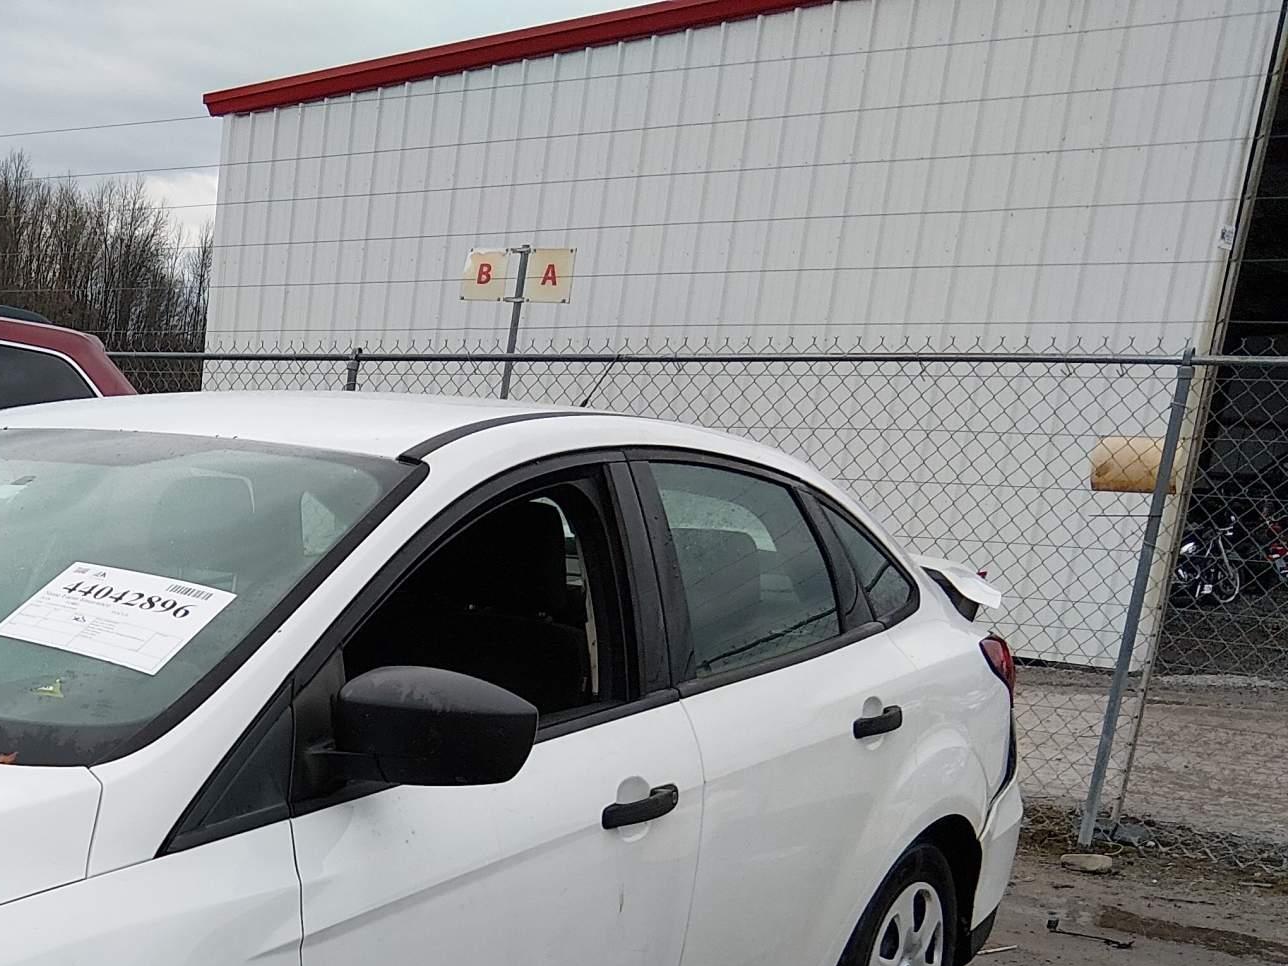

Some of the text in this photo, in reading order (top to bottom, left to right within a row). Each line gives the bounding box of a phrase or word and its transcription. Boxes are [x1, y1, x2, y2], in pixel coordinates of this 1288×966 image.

[476, 263, 492, 285] B
[540, 263, 557, 286] A
[63, 580, 197, 619] 44042896
